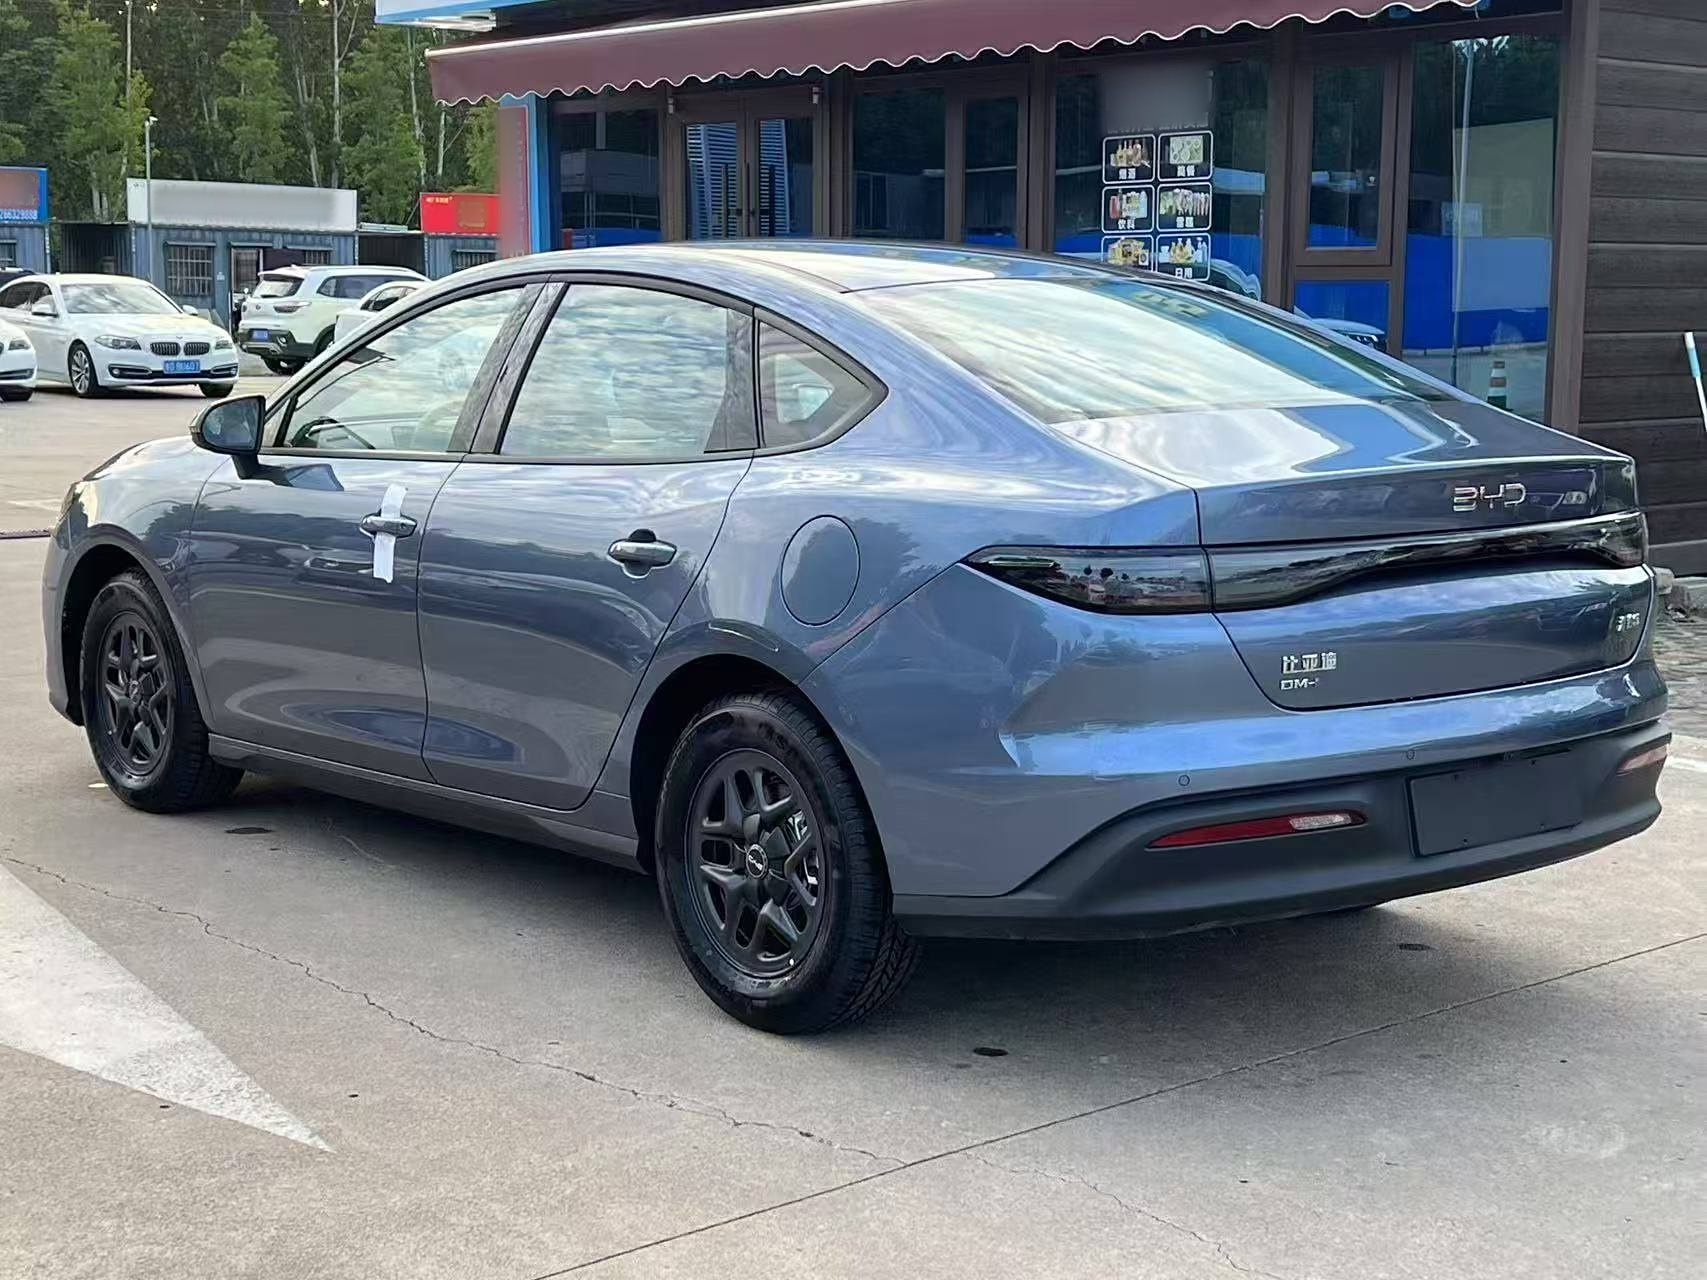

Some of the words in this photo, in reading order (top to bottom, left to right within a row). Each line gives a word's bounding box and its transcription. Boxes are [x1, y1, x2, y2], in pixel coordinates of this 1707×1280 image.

[1118, 218, 1135, 230] 饮料
[1175, 267, 1193, 279] 日用
[1452, 482, 1527, 512] BYD
[1282, 652, 1337, 674] 比亚迪
